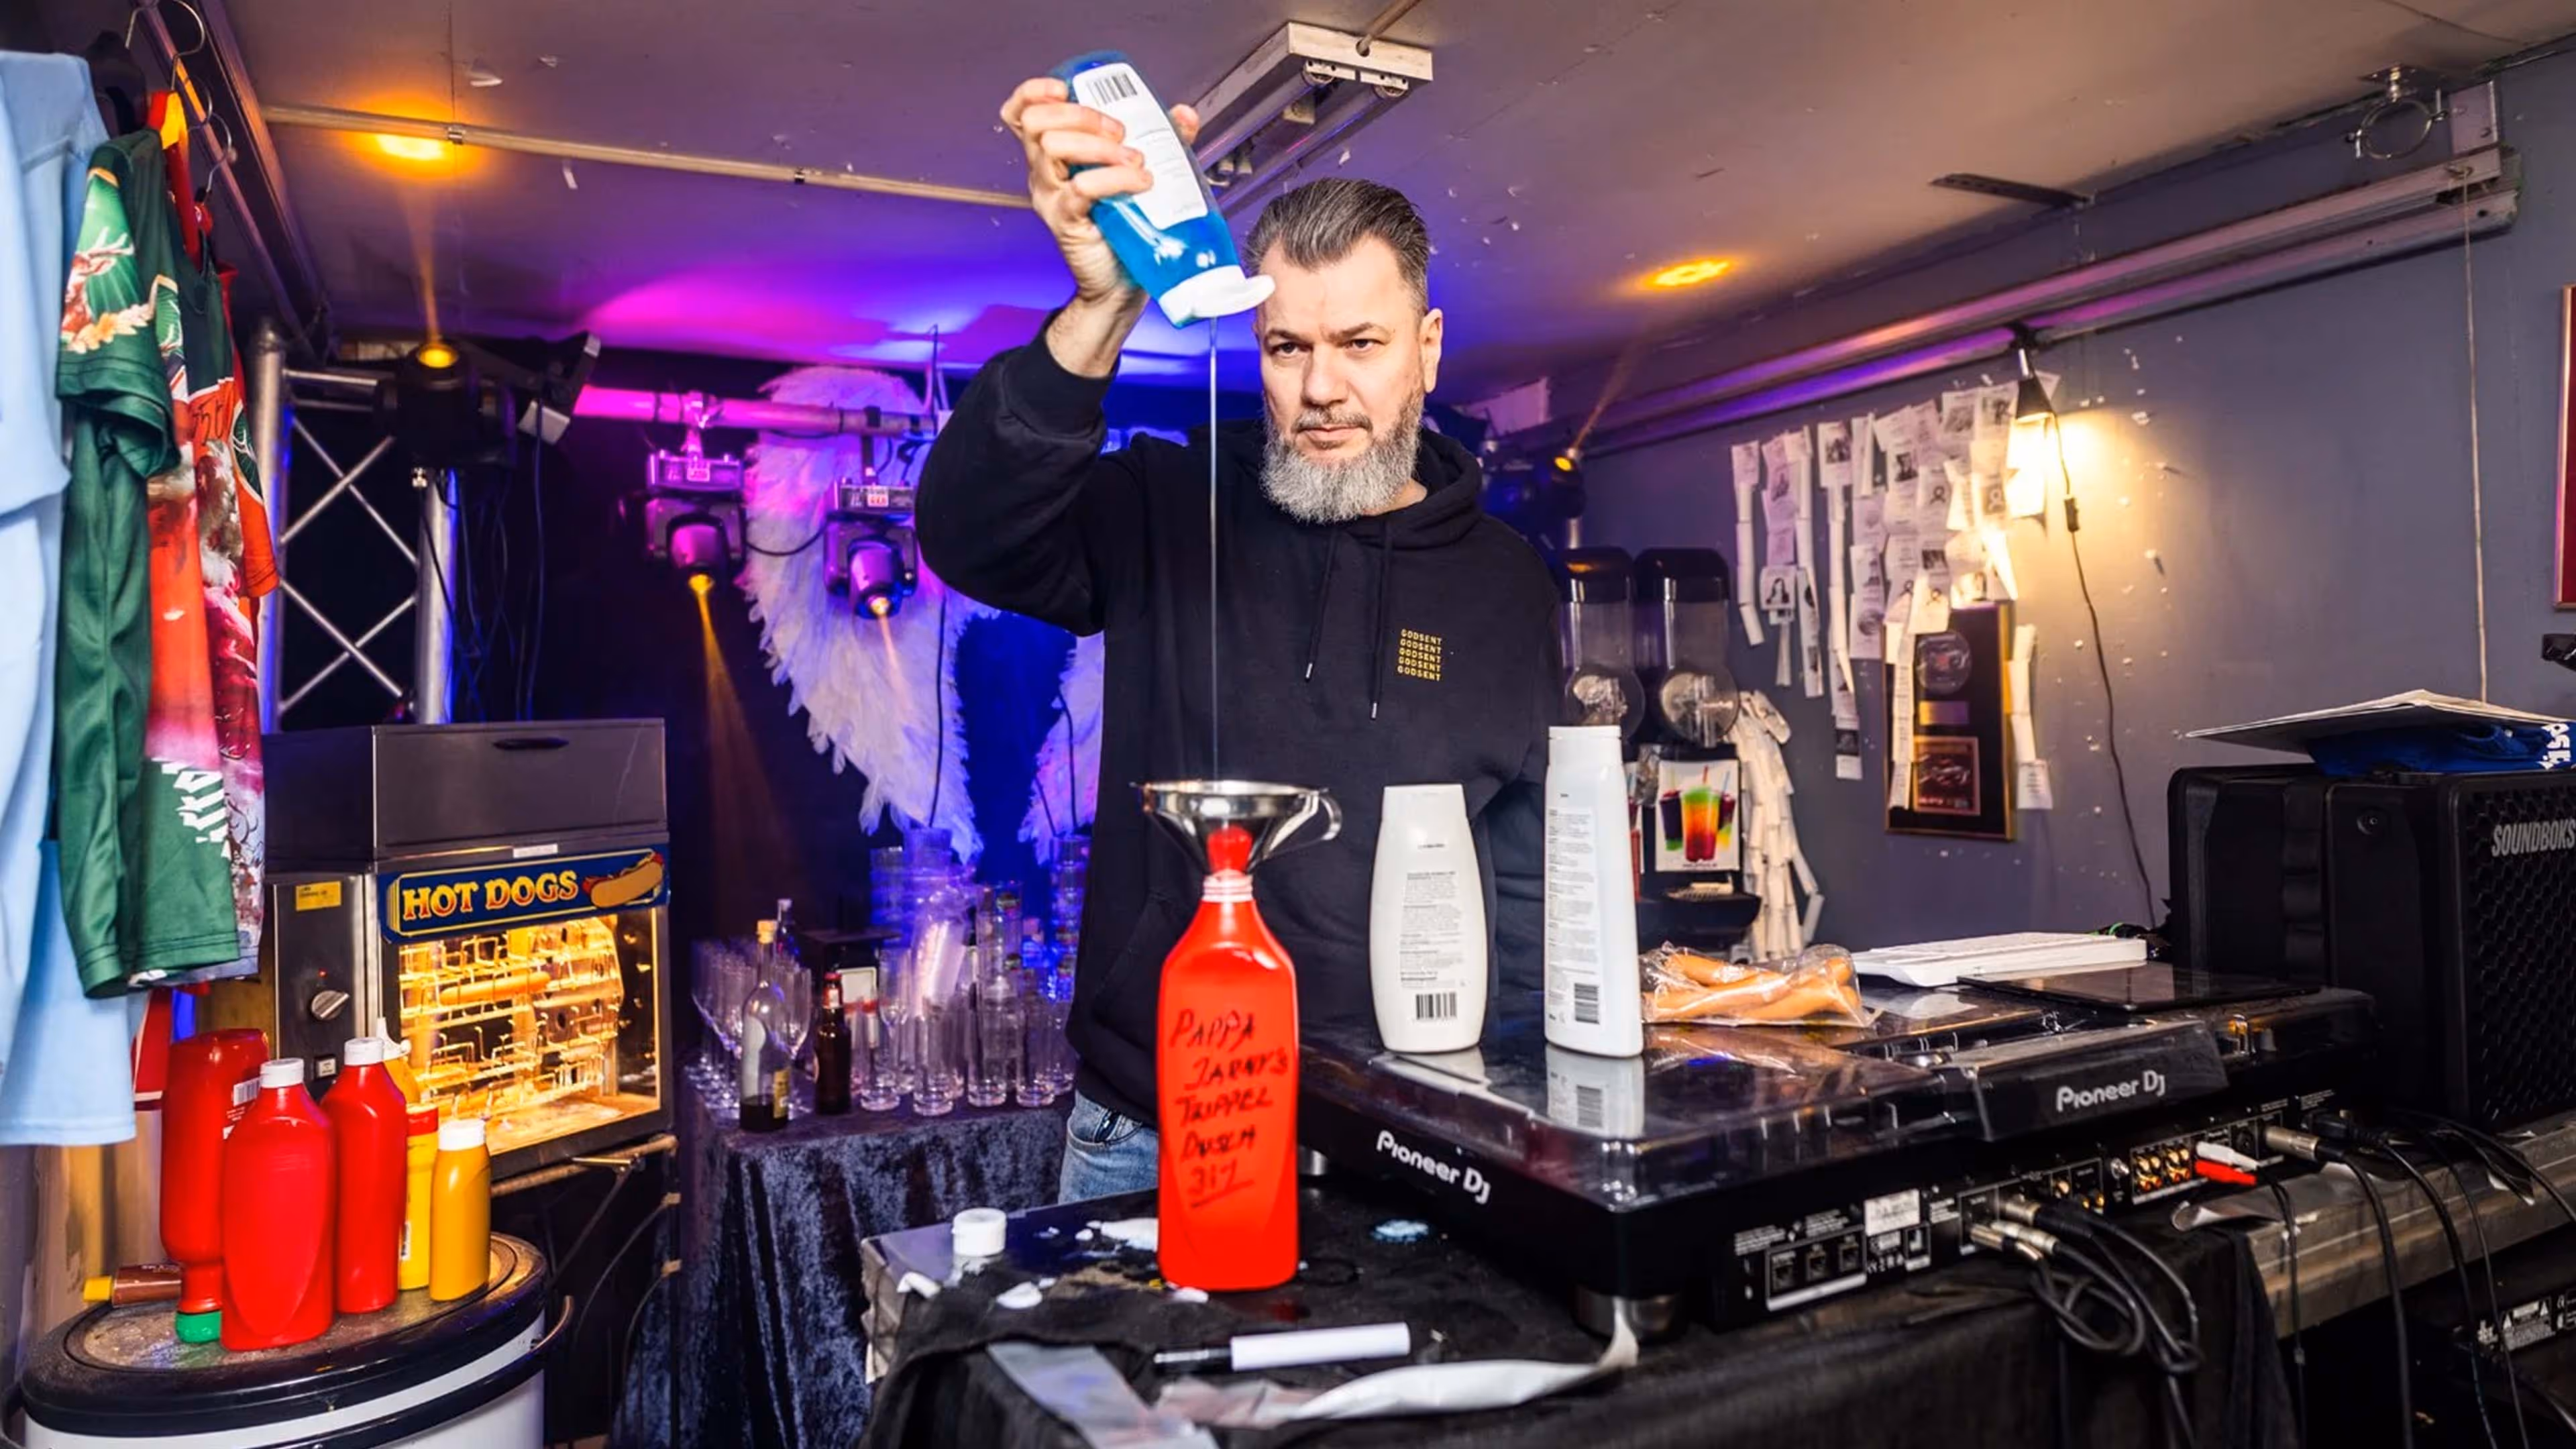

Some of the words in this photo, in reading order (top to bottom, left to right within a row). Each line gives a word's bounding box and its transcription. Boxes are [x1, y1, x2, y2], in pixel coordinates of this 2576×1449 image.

[1400, 638, 1442, 654] GODSENT
[1401, 629, 1442, 645] GODSENT
[1398, 656, 1441, 672] GODSENT
[1399, 647, 1441, 663] GODSENT
[1397, 665, 1441, 682] GODSENT
[2491, 818, 2576, 857] SOUNDBOKS
[402, 881, 478, 921] HOT
[485, 869, 579, 910] DOGS
[1169, 1008, 1256, 1052] PAPPA
[2056, 1079, 2139, 1112] Pioneer
[1377, 1130, 1460, 1184] Pioneer
